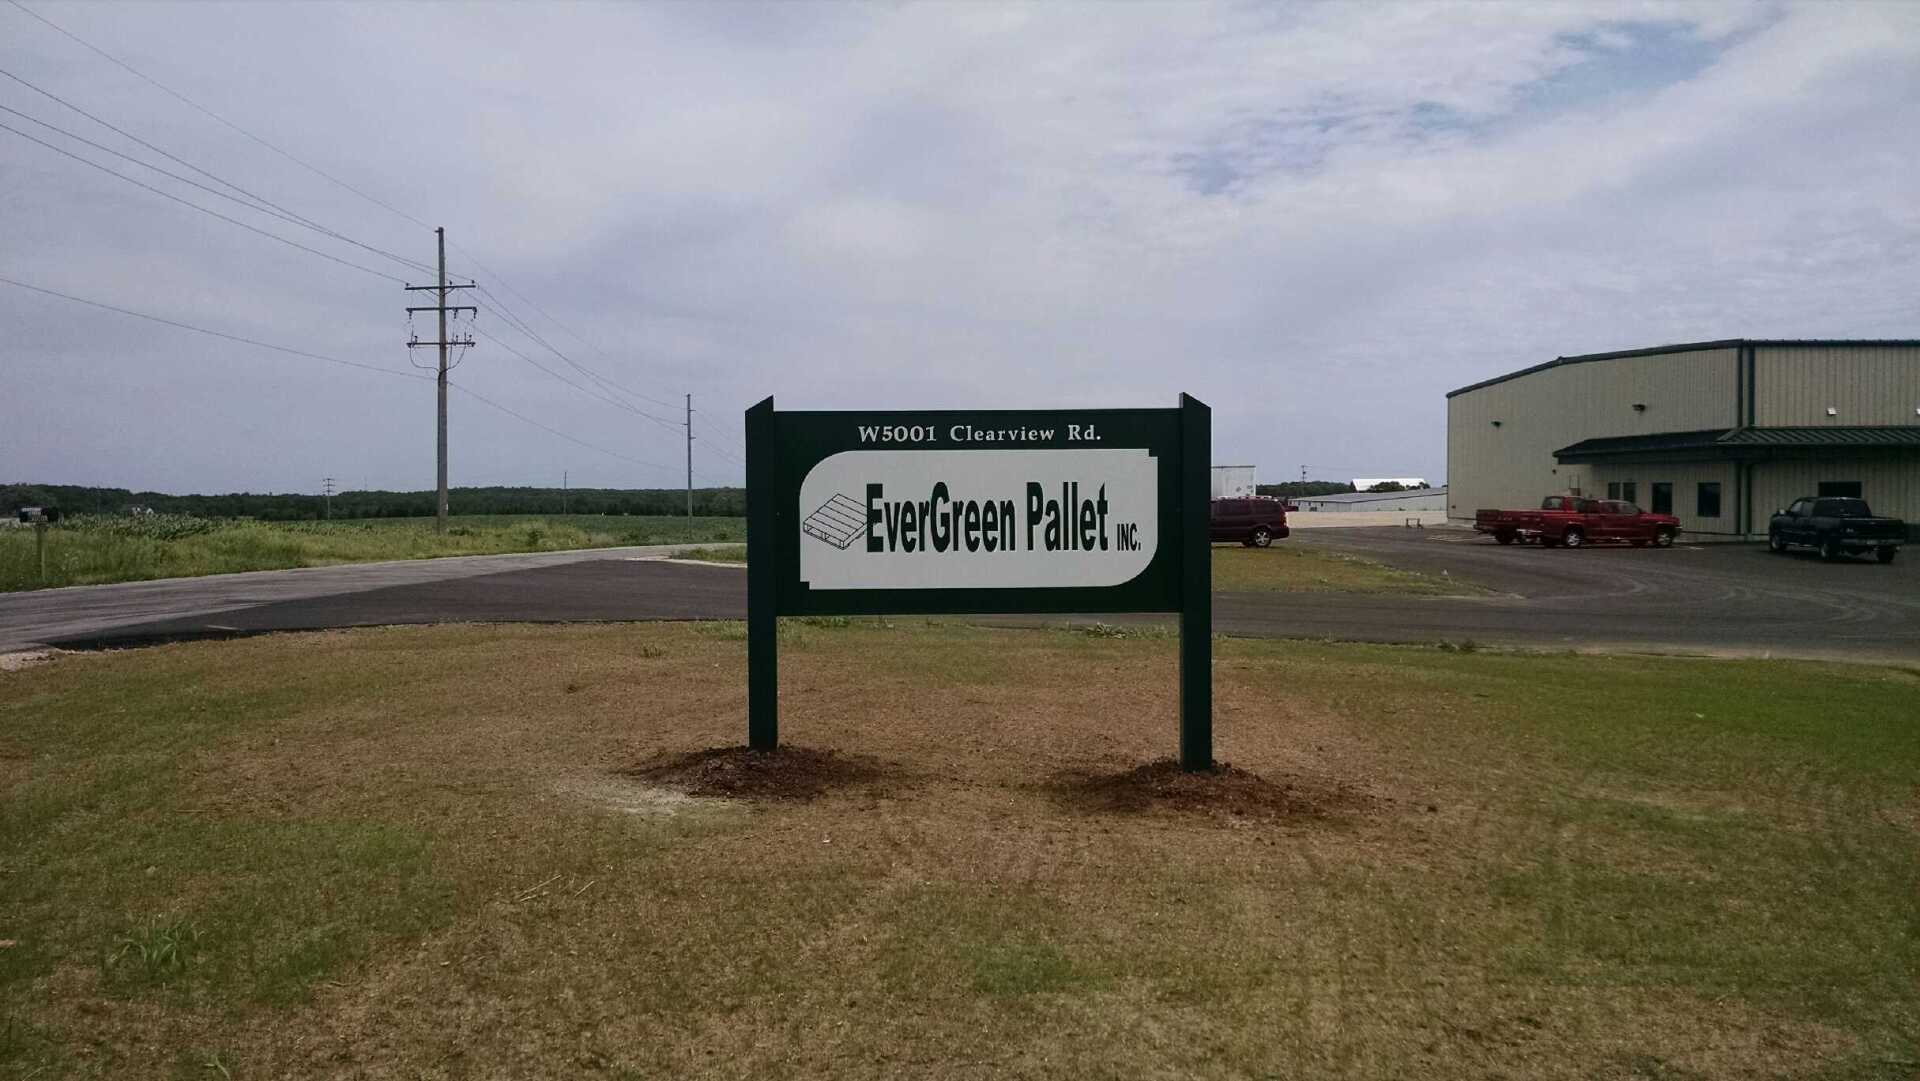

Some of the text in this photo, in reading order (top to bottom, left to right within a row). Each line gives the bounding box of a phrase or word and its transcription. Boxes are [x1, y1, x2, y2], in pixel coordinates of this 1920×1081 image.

[858, 424, 1101, 443] W5001 Clearview Rd.
[866, 481, 1142, 554] EverGreen Pallet INC.
